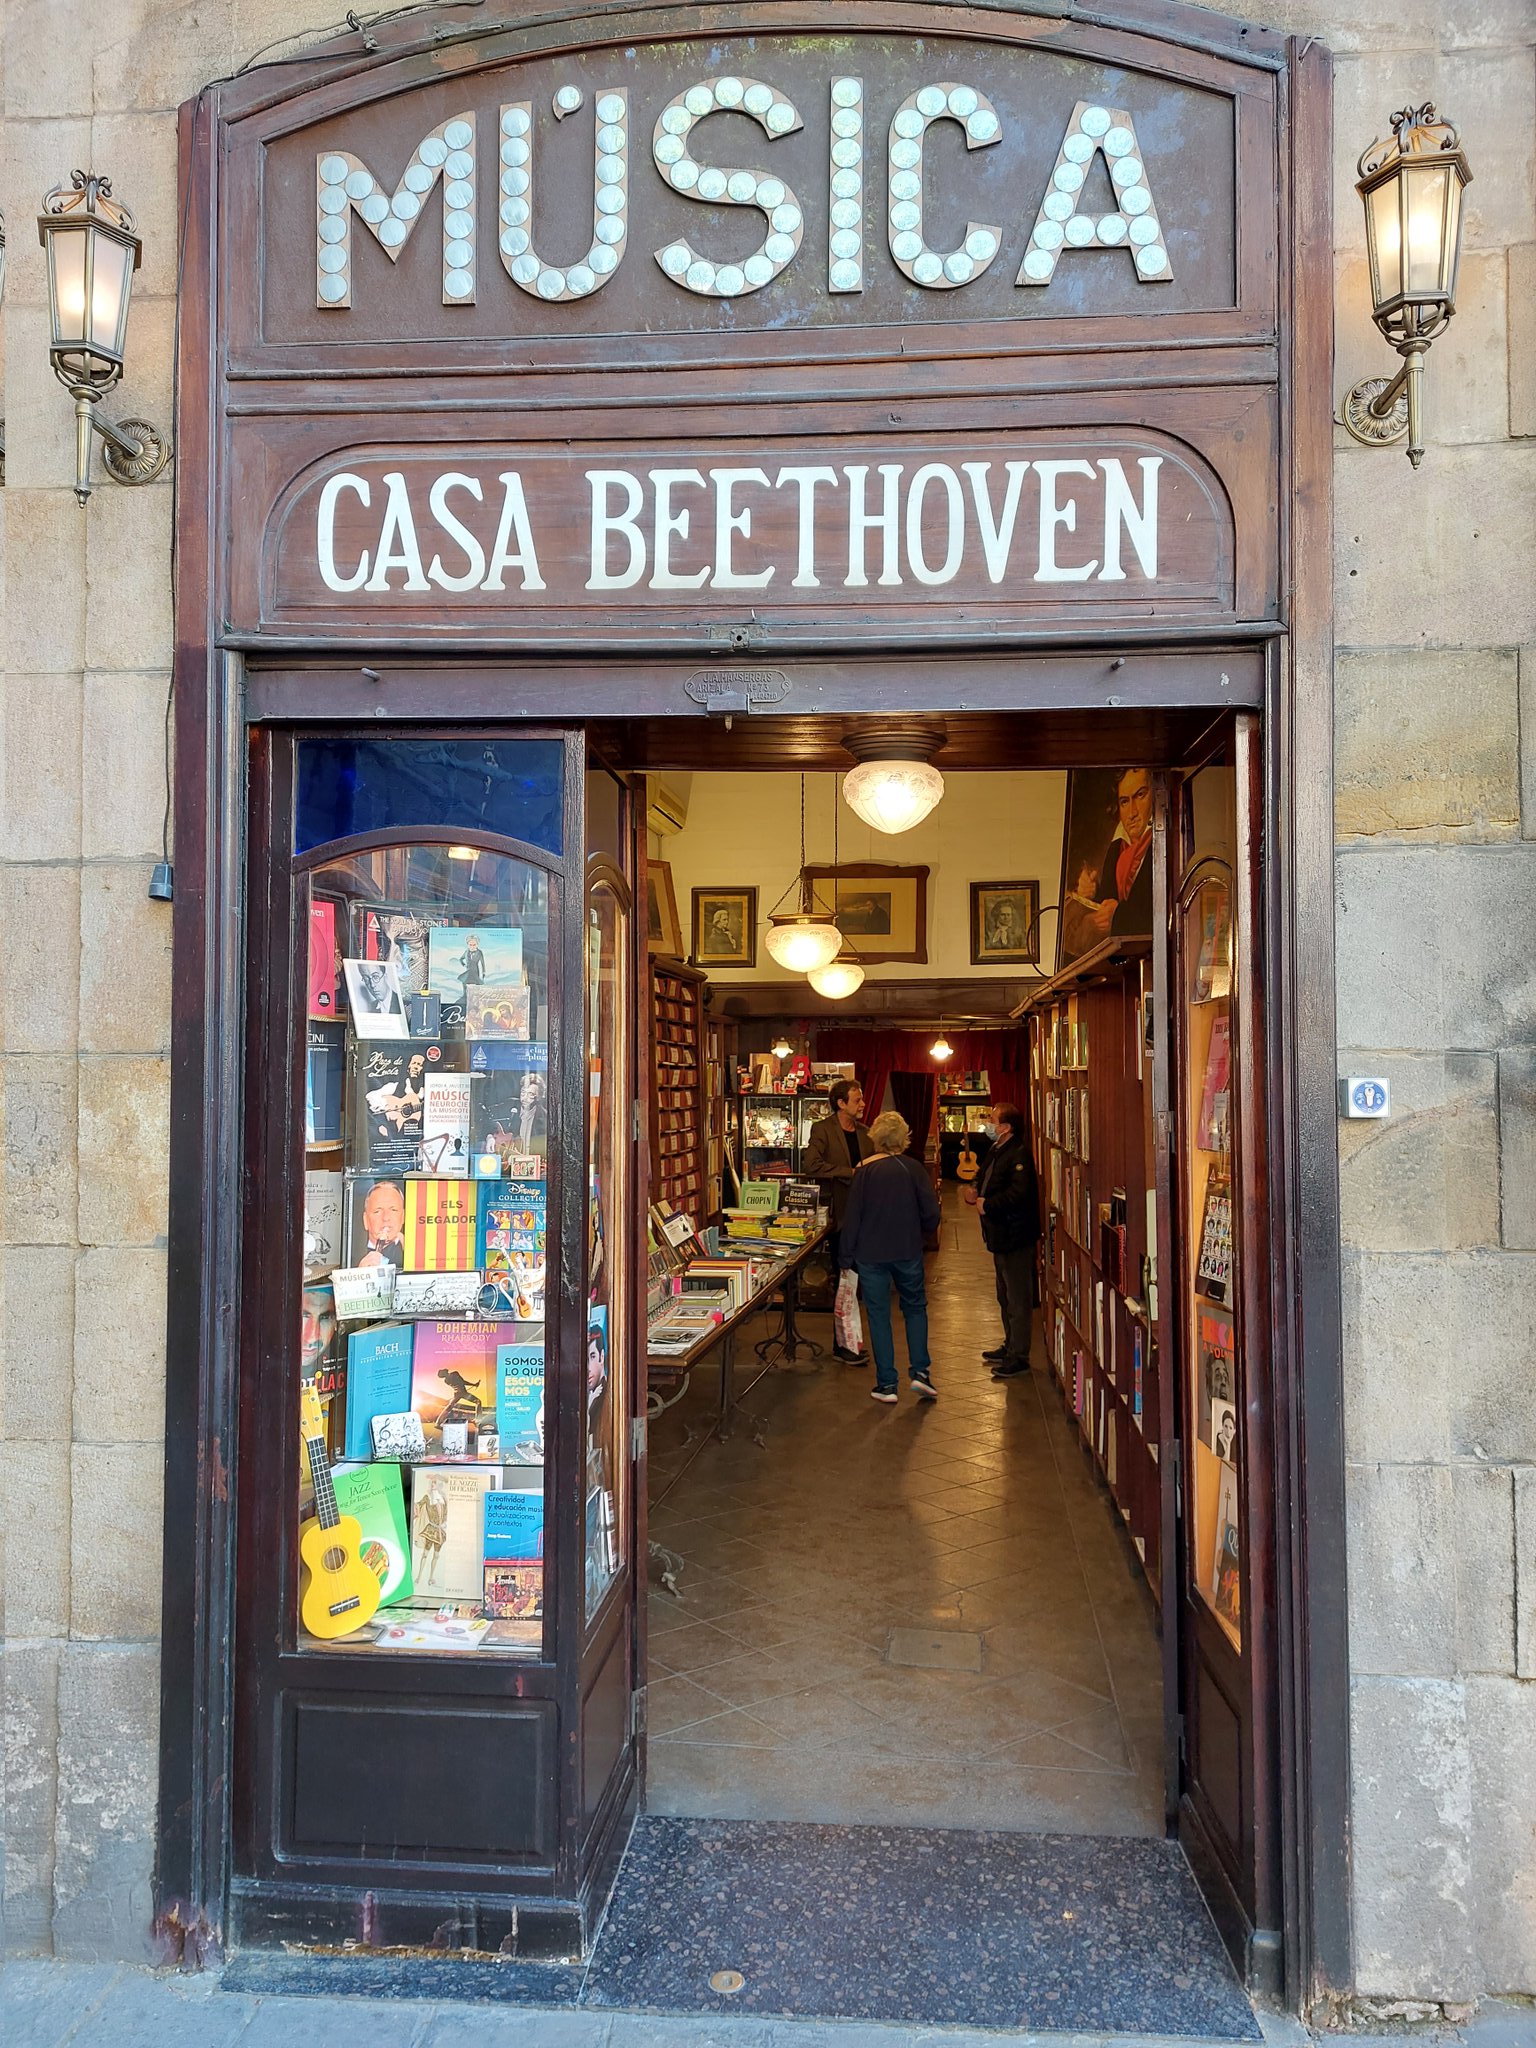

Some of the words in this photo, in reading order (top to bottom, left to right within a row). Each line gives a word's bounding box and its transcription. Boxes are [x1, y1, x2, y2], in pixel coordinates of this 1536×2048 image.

[316, 75, 1174, 310] MÚSICA
[316, 470, 547, 594] CASA
[584, 456, 1164, 592] BEETHOVEN
[419, 919, 447, 927] STONES
[393, 1056, 403, 1066] de
[430, 1089, 469, 1101] MÚSIC
[789, 1190, 812, 1198] Beatles
[441, 1200, 463, 1209] ELS
[746, 1196, 772, 1205] CHOPIN
[784, 1195, 809, 1204] Classics
[418, 1215, 476, 1225] SEGADOR
[340, 1272, 371, 1282] MÚSICA
[436, 1322, 497, 1334] BOHEMIAN
[441, 1334, 491, 1344] RHAPSODY
[375, 1342, 399, 1355] BACH
[504, 1357, 544, 1366] SOMOS
[505, 1368, 519, 1376] LO
[522, 1368, 544, 1376] QUE
[505, 1386, 530, 1396] MOS
[348, 1481, 371, 1499] JAZZ
[488, 1494, 525, 1503] Creatividad
[494, 1503, 526, 1511] educación
[487, 1511, 536, 1520] actualizaciones
